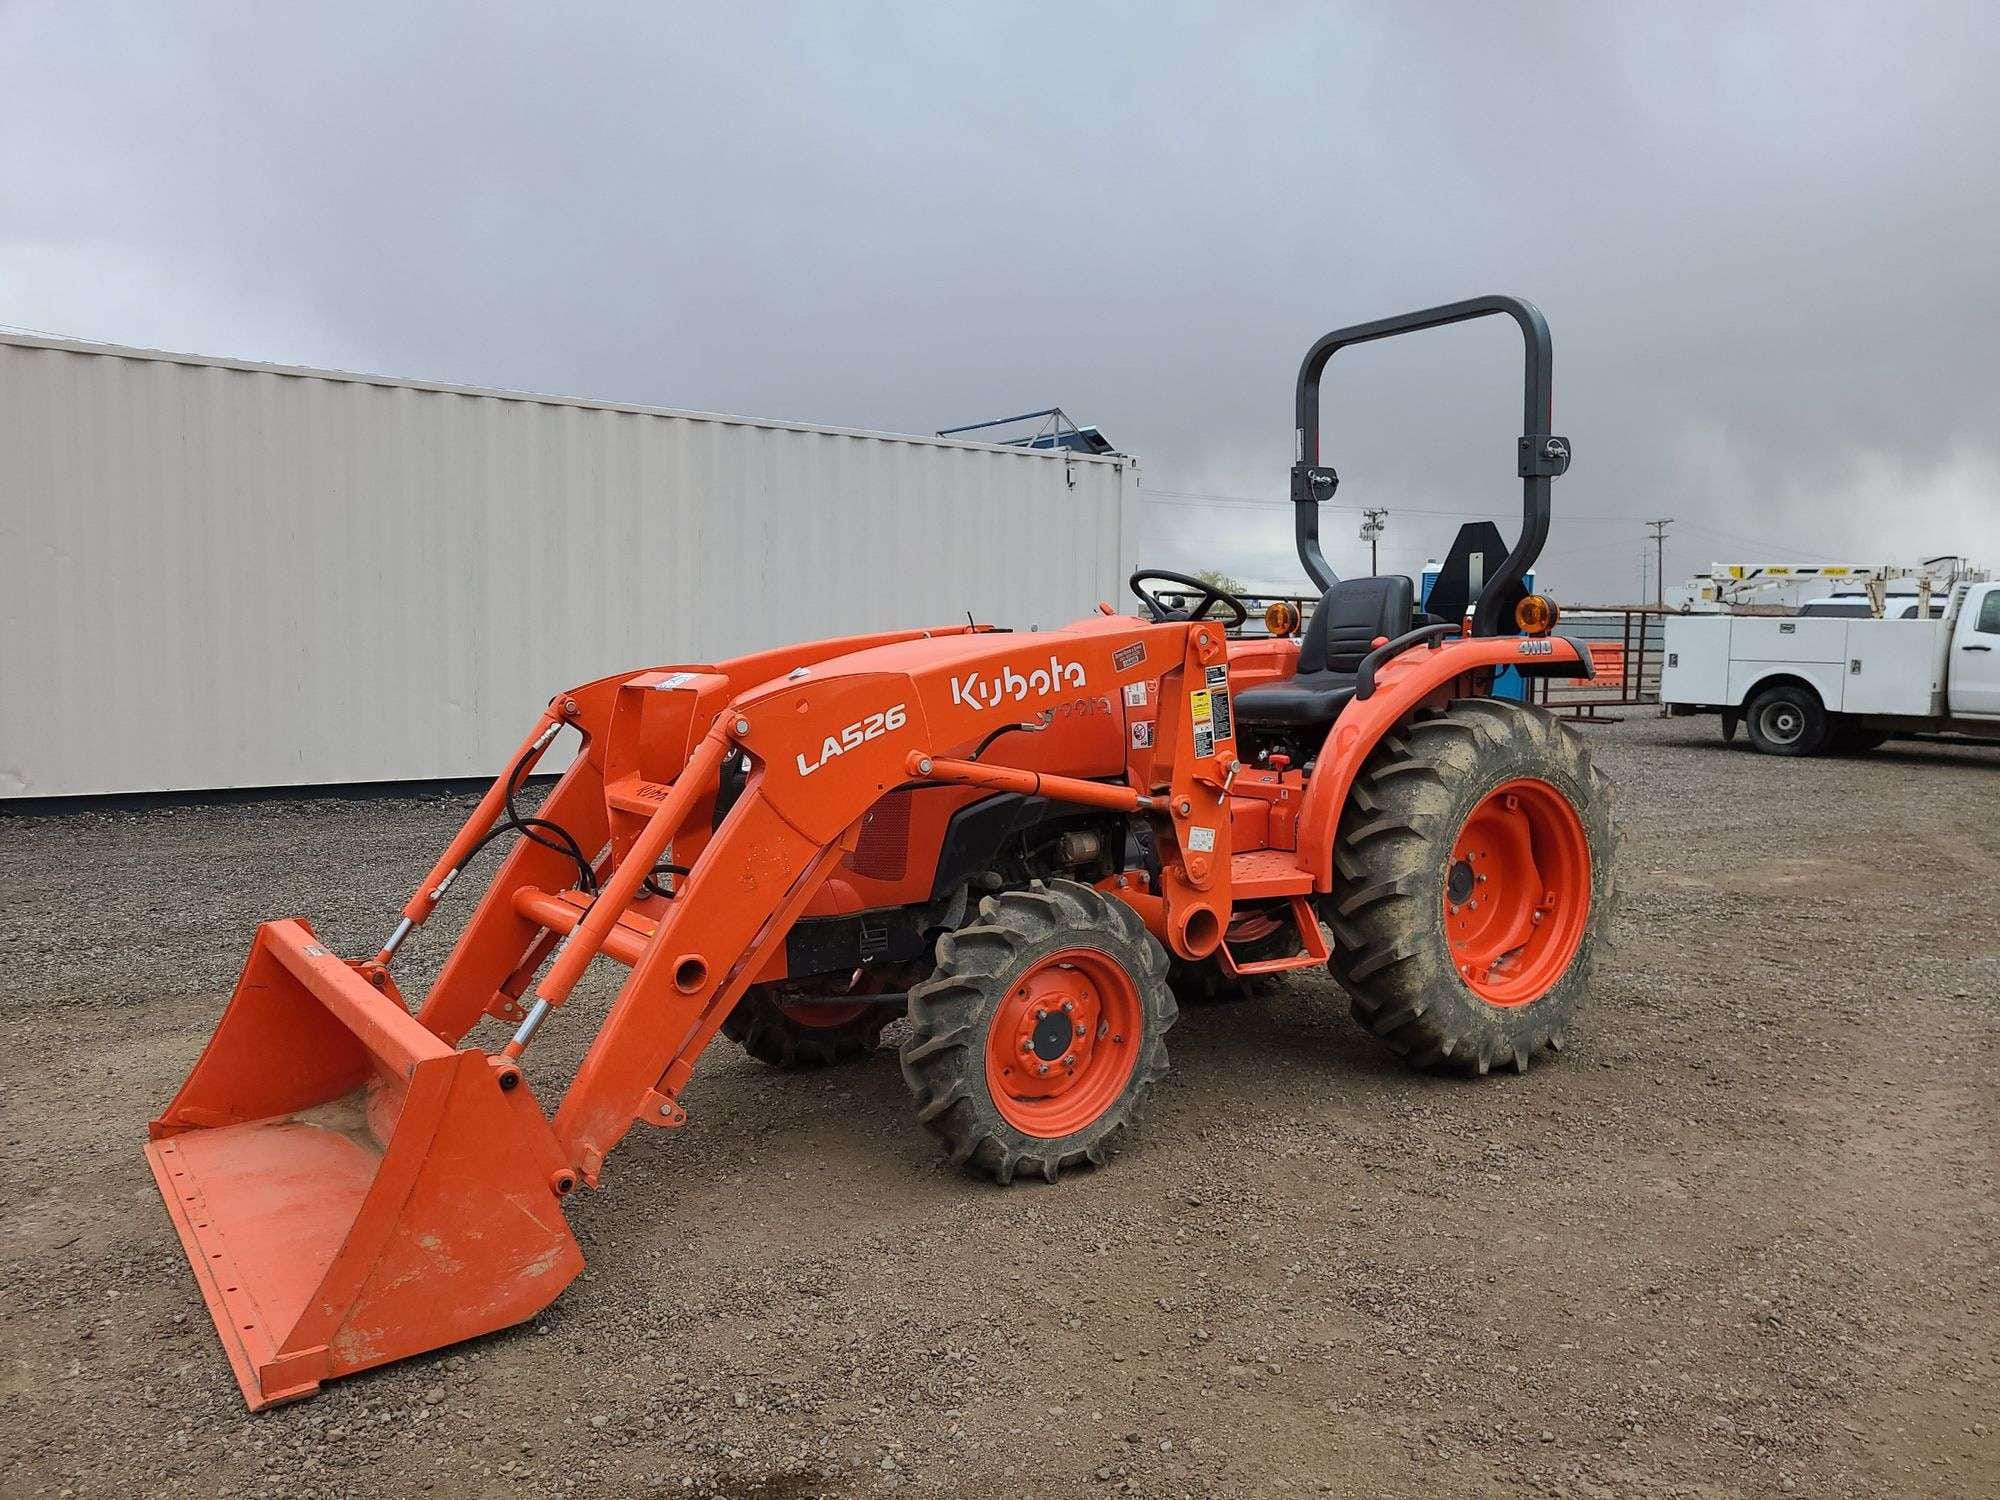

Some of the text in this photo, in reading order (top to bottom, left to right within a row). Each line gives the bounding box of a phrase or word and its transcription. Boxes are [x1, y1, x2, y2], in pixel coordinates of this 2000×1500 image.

[1518, 640, 1552, 655] 4WD
[950, 655, 1087, 711] Kubota
[796, 703, 907, 777] LA526
